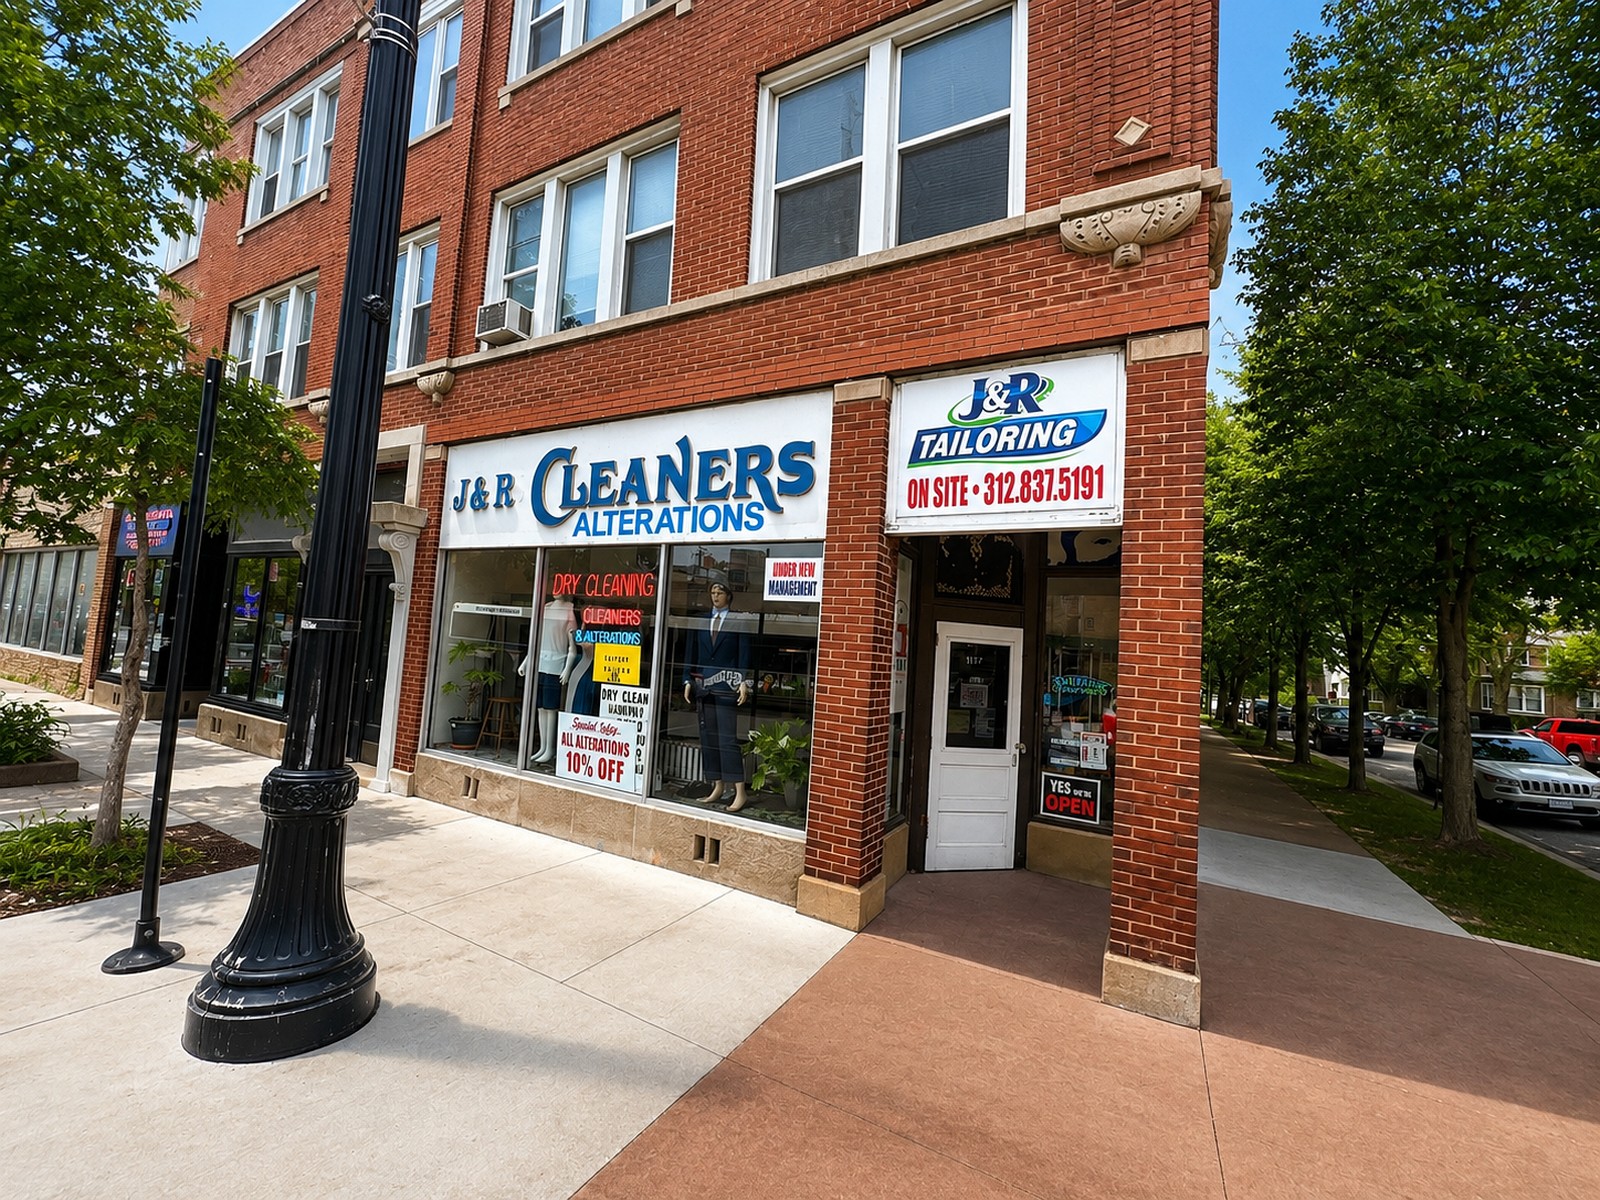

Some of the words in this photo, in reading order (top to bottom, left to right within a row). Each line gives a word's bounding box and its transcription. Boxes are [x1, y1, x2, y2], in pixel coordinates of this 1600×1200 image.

[958, 372, 1043, 421] J&R
[919, 419, 1077, 460] TAILORING
[531, 435, 816, 528] CLEANERS
[907, 479, 930, 509] ON
[933, 475, 969, 508] SITE
[983, 464, 1105, 506] 312.837.5191
[572, 501, 765, 537] ALTERATIONS
[773, 561, 797, 578] UNDER
[798, 561, 816, 578] NEW
[552, 573, 581, 596] DRY
[585, 573, 655, 597] CLEANING
[768, 579, 818, 597] MANAGEMENT
[583, 607, 641, 626] CLEANERS
[602, 688, 618, 702] DRY
[561, 731, 574, 748] ALL
[575, 734, 630, 758] ALTERATIONS
[566, 750, 593, 778] 10%
[598, 757, 625, 783] OFF
[1050, 779, 1071, 795] YES
[1045, 793, 1095, 817] OPEN
